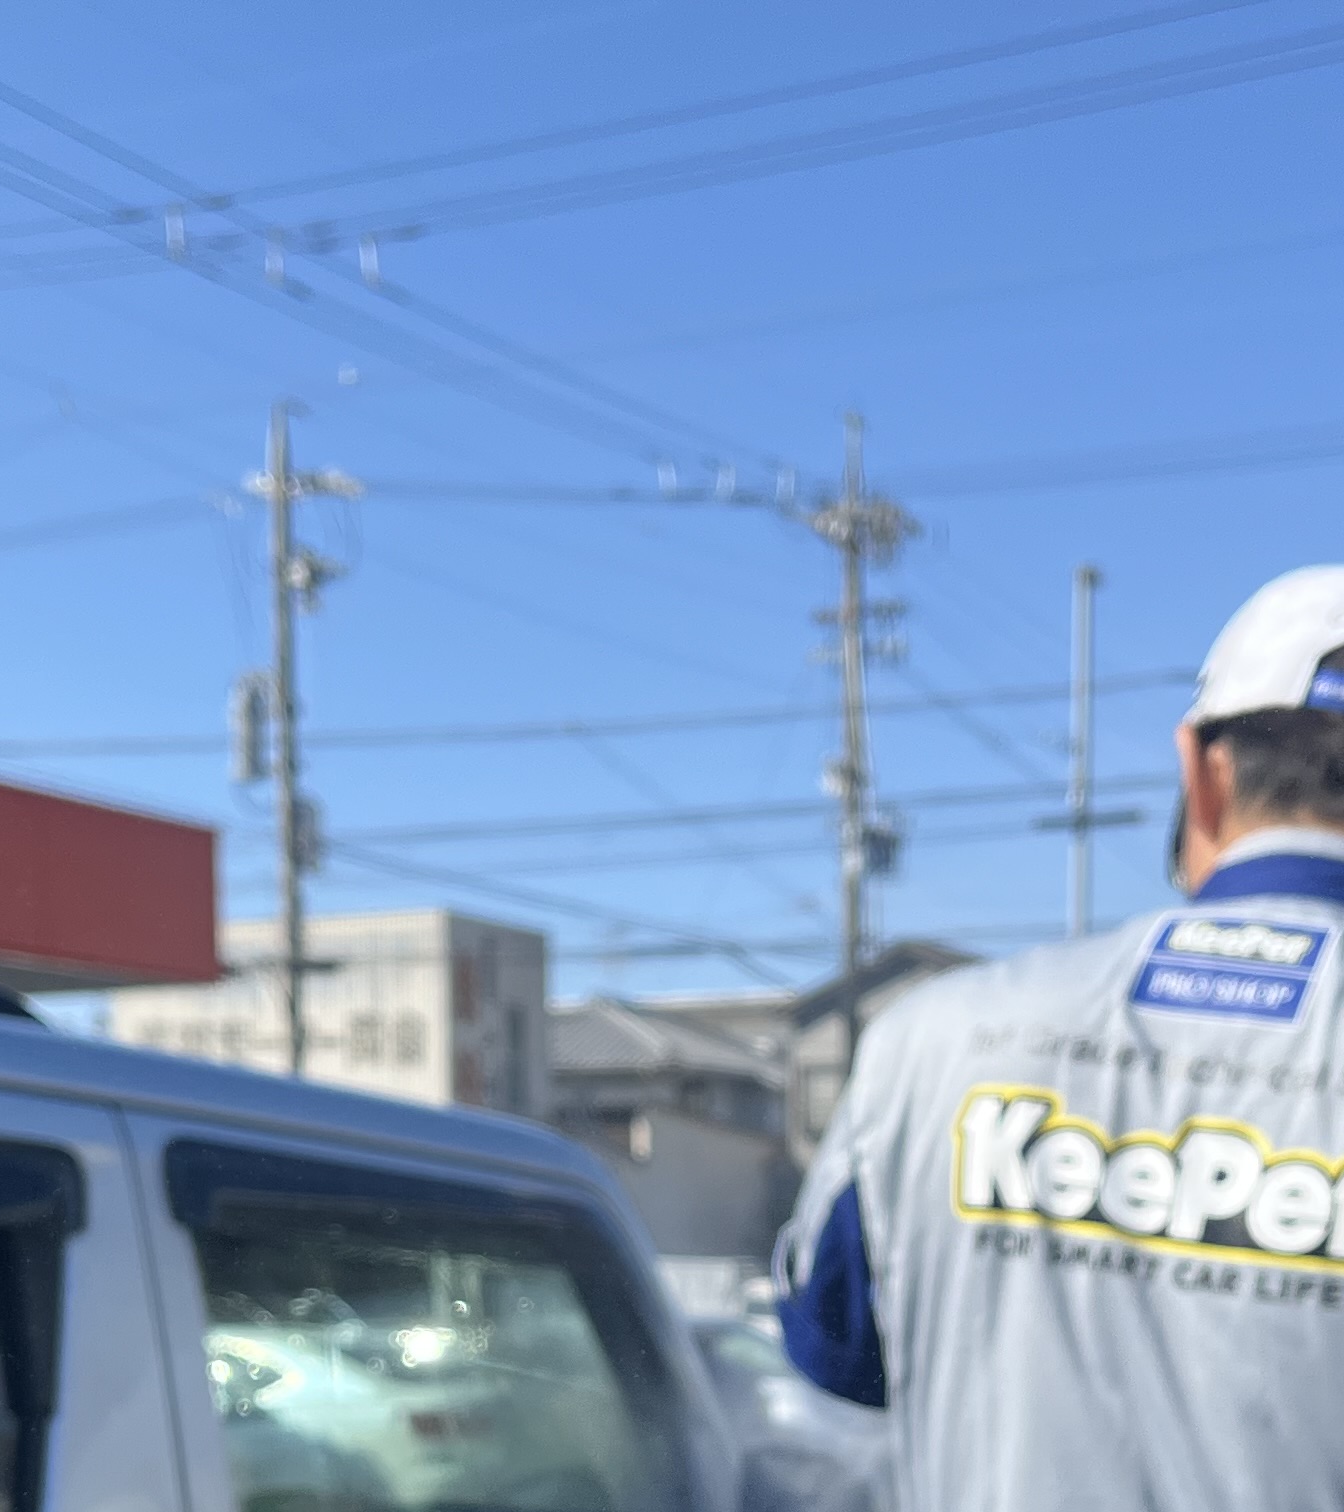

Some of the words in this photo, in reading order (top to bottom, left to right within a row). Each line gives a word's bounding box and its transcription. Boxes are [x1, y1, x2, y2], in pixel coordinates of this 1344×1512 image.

[1051, 1238, 1158, 1281] SMART
[1173, 1261, 1242, 1296] CAR
[1257, 1272, 1344, 1308] LIFE
